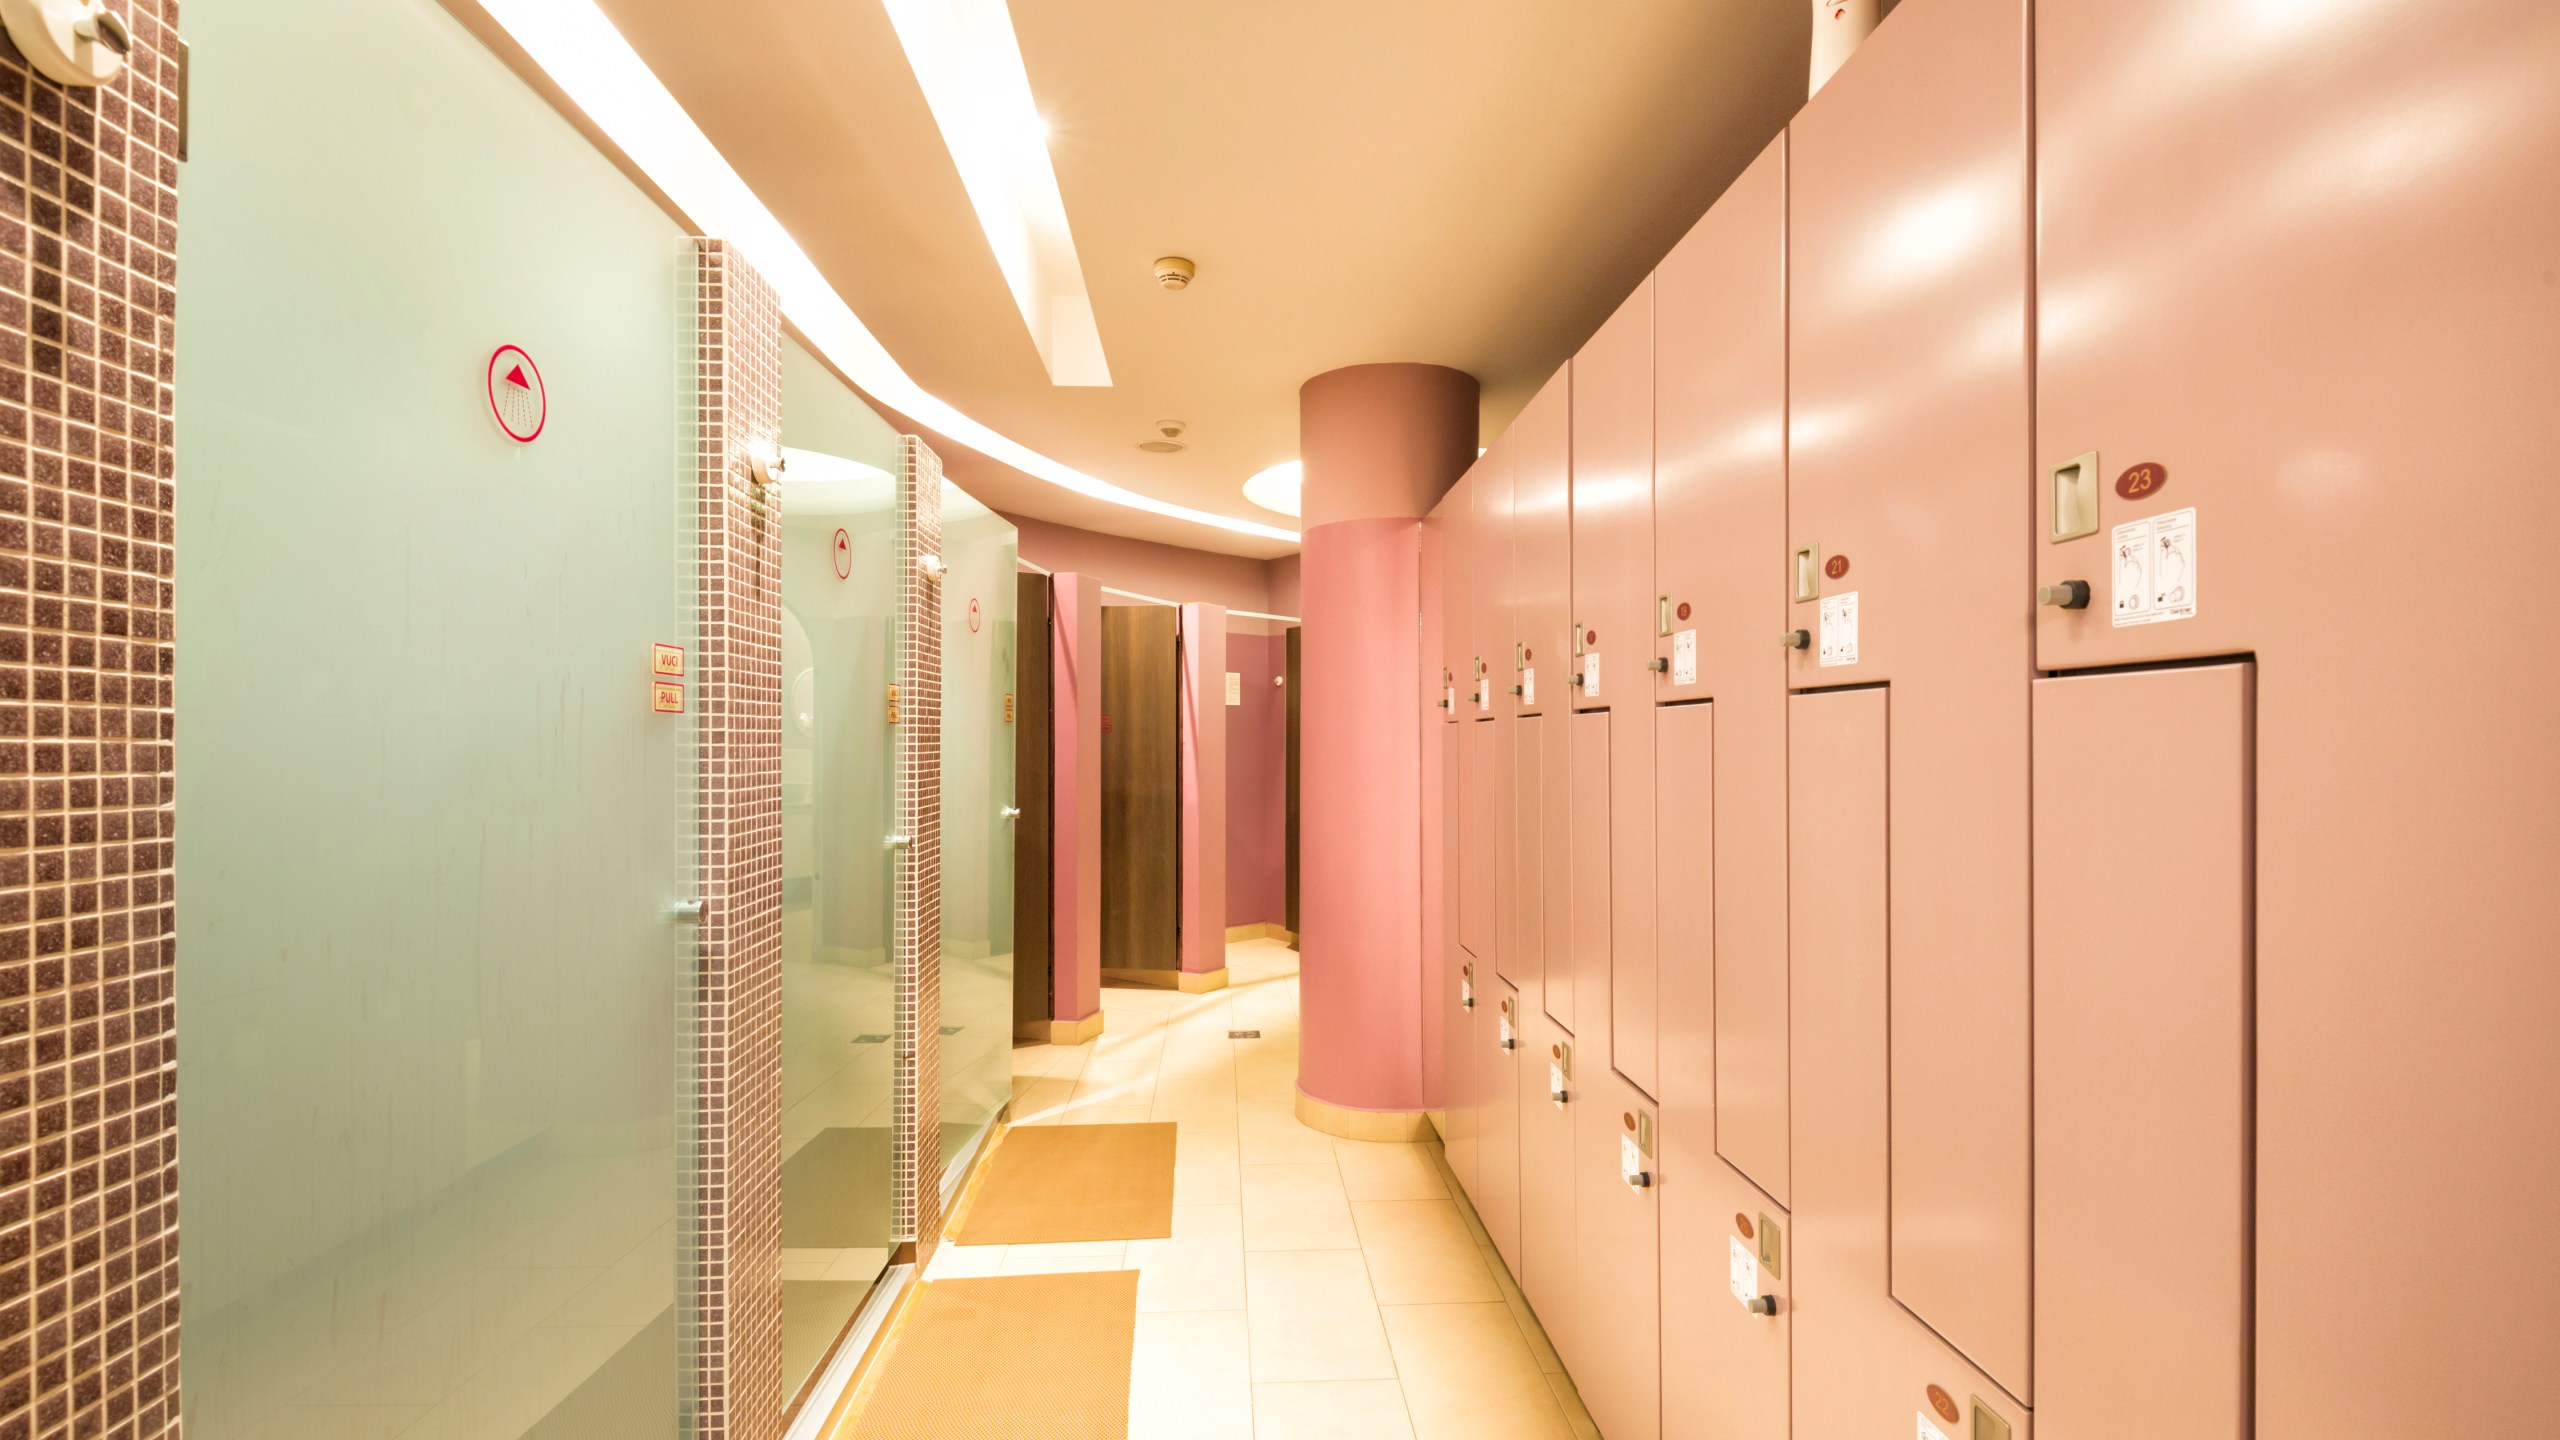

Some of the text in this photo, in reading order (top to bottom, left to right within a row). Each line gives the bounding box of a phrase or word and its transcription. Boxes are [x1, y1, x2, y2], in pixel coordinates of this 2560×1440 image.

[2128, 468, 2152, 494] 23
[1831, 559, 1842, 575] 21
[661, 692, 678, 703] PULL
[1935, 1391, 1949, 1415] 22
